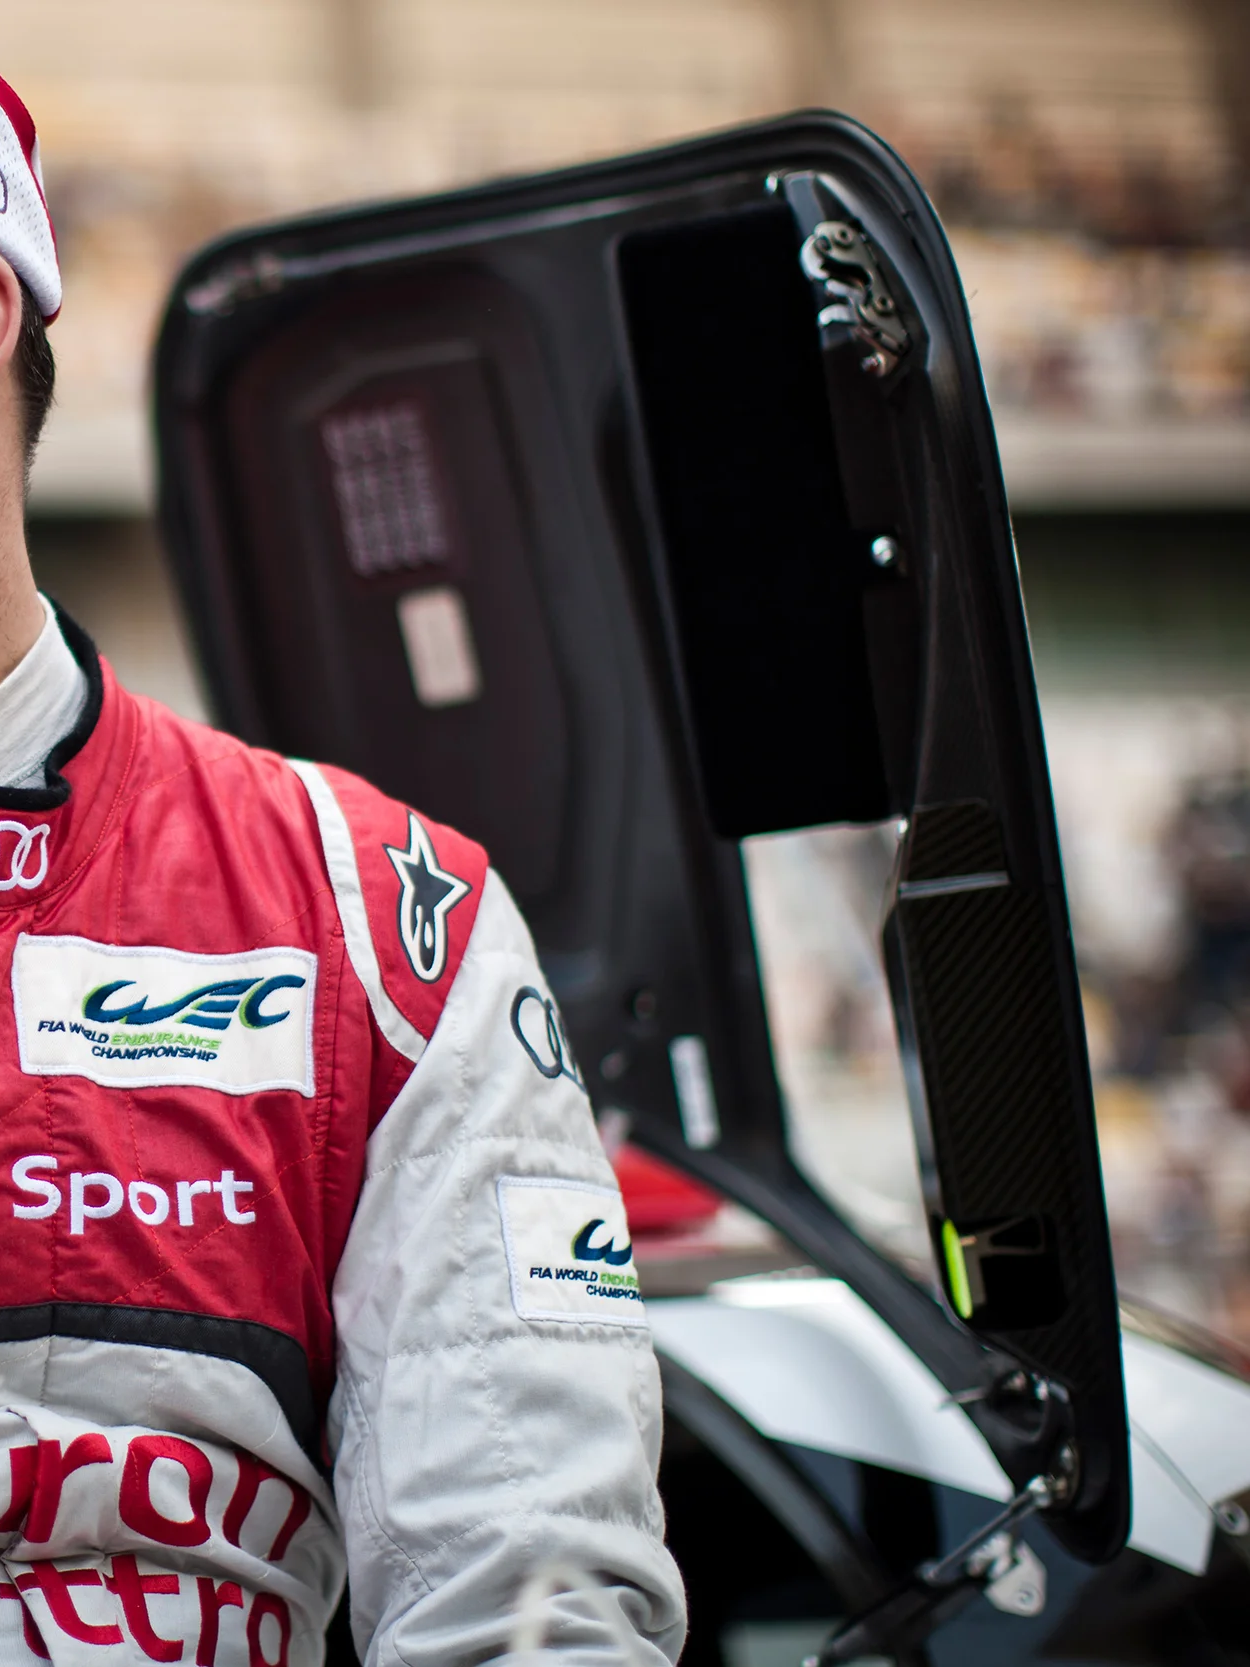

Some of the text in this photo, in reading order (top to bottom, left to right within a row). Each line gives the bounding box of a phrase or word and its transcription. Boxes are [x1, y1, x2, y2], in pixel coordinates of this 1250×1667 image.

[81, 974, 306, 1030] WEC
[38, 1020, 66, 1032] FIA
[111, 1032, 222, 1051] ENDURANCE
[91, 1046, 218, 1062] CHAMPIONSHIP
[11, 1155, 257, 1235] Sport
[530, 1267, 640, 1288] FIA WORLD ENDUR
